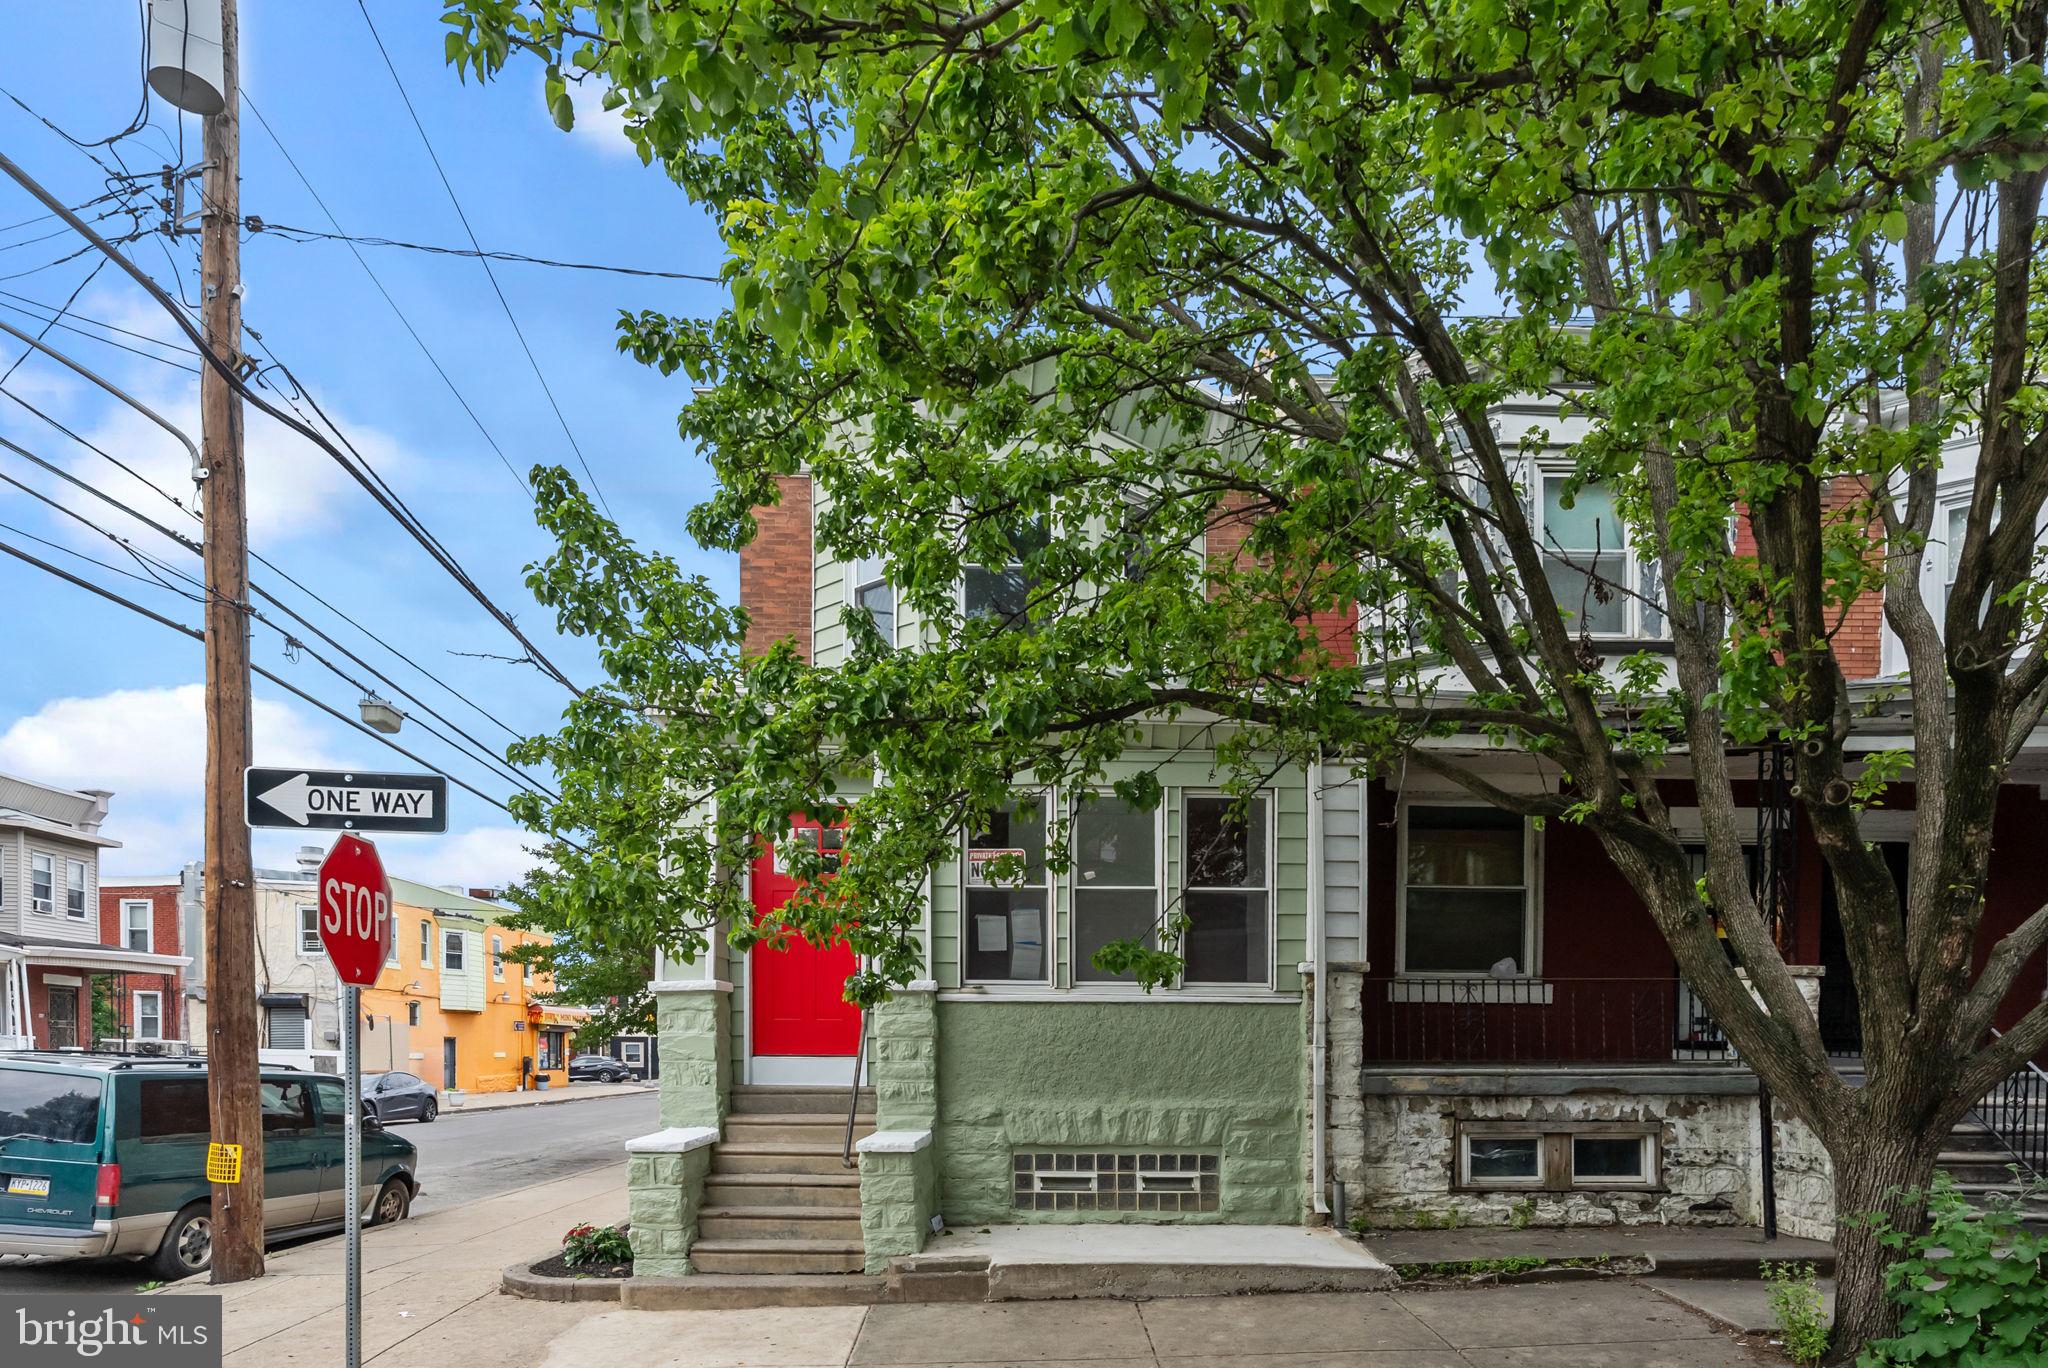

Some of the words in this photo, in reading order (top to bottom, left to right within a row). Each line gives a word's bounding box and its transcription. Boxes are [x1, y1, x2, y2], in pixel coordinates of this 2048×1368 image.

[308, 789, 360, 812] ONE
[371, 791, 425, 814] WAY
[324, 878, 388, 941] STOP
[27, 1207, 73, 1216] CHEVROLET
